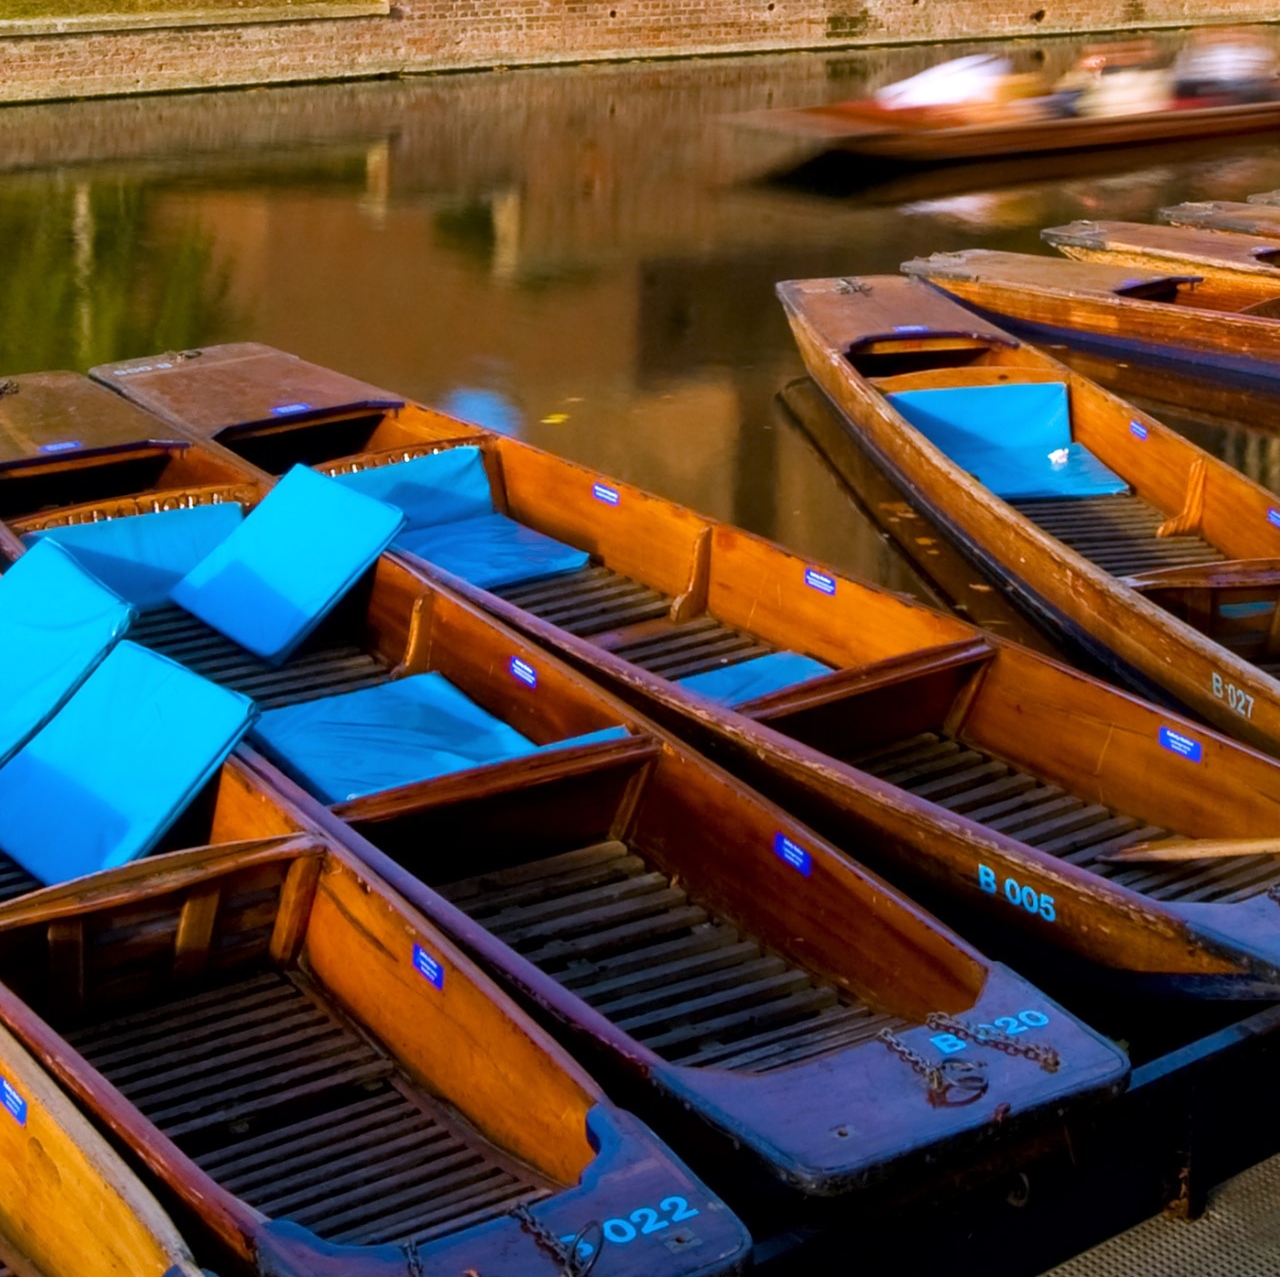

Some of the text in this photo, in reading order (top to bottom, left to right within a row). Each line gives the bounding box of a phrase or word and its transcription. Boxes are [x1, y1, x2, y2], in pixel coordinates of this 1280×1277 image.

[1212, 672, 1254, 719] B 027
[978, 863, 1056, 922] B 005
[929, 1032, 967, 1054] B
[603, 1195, 700, 1243] 022
